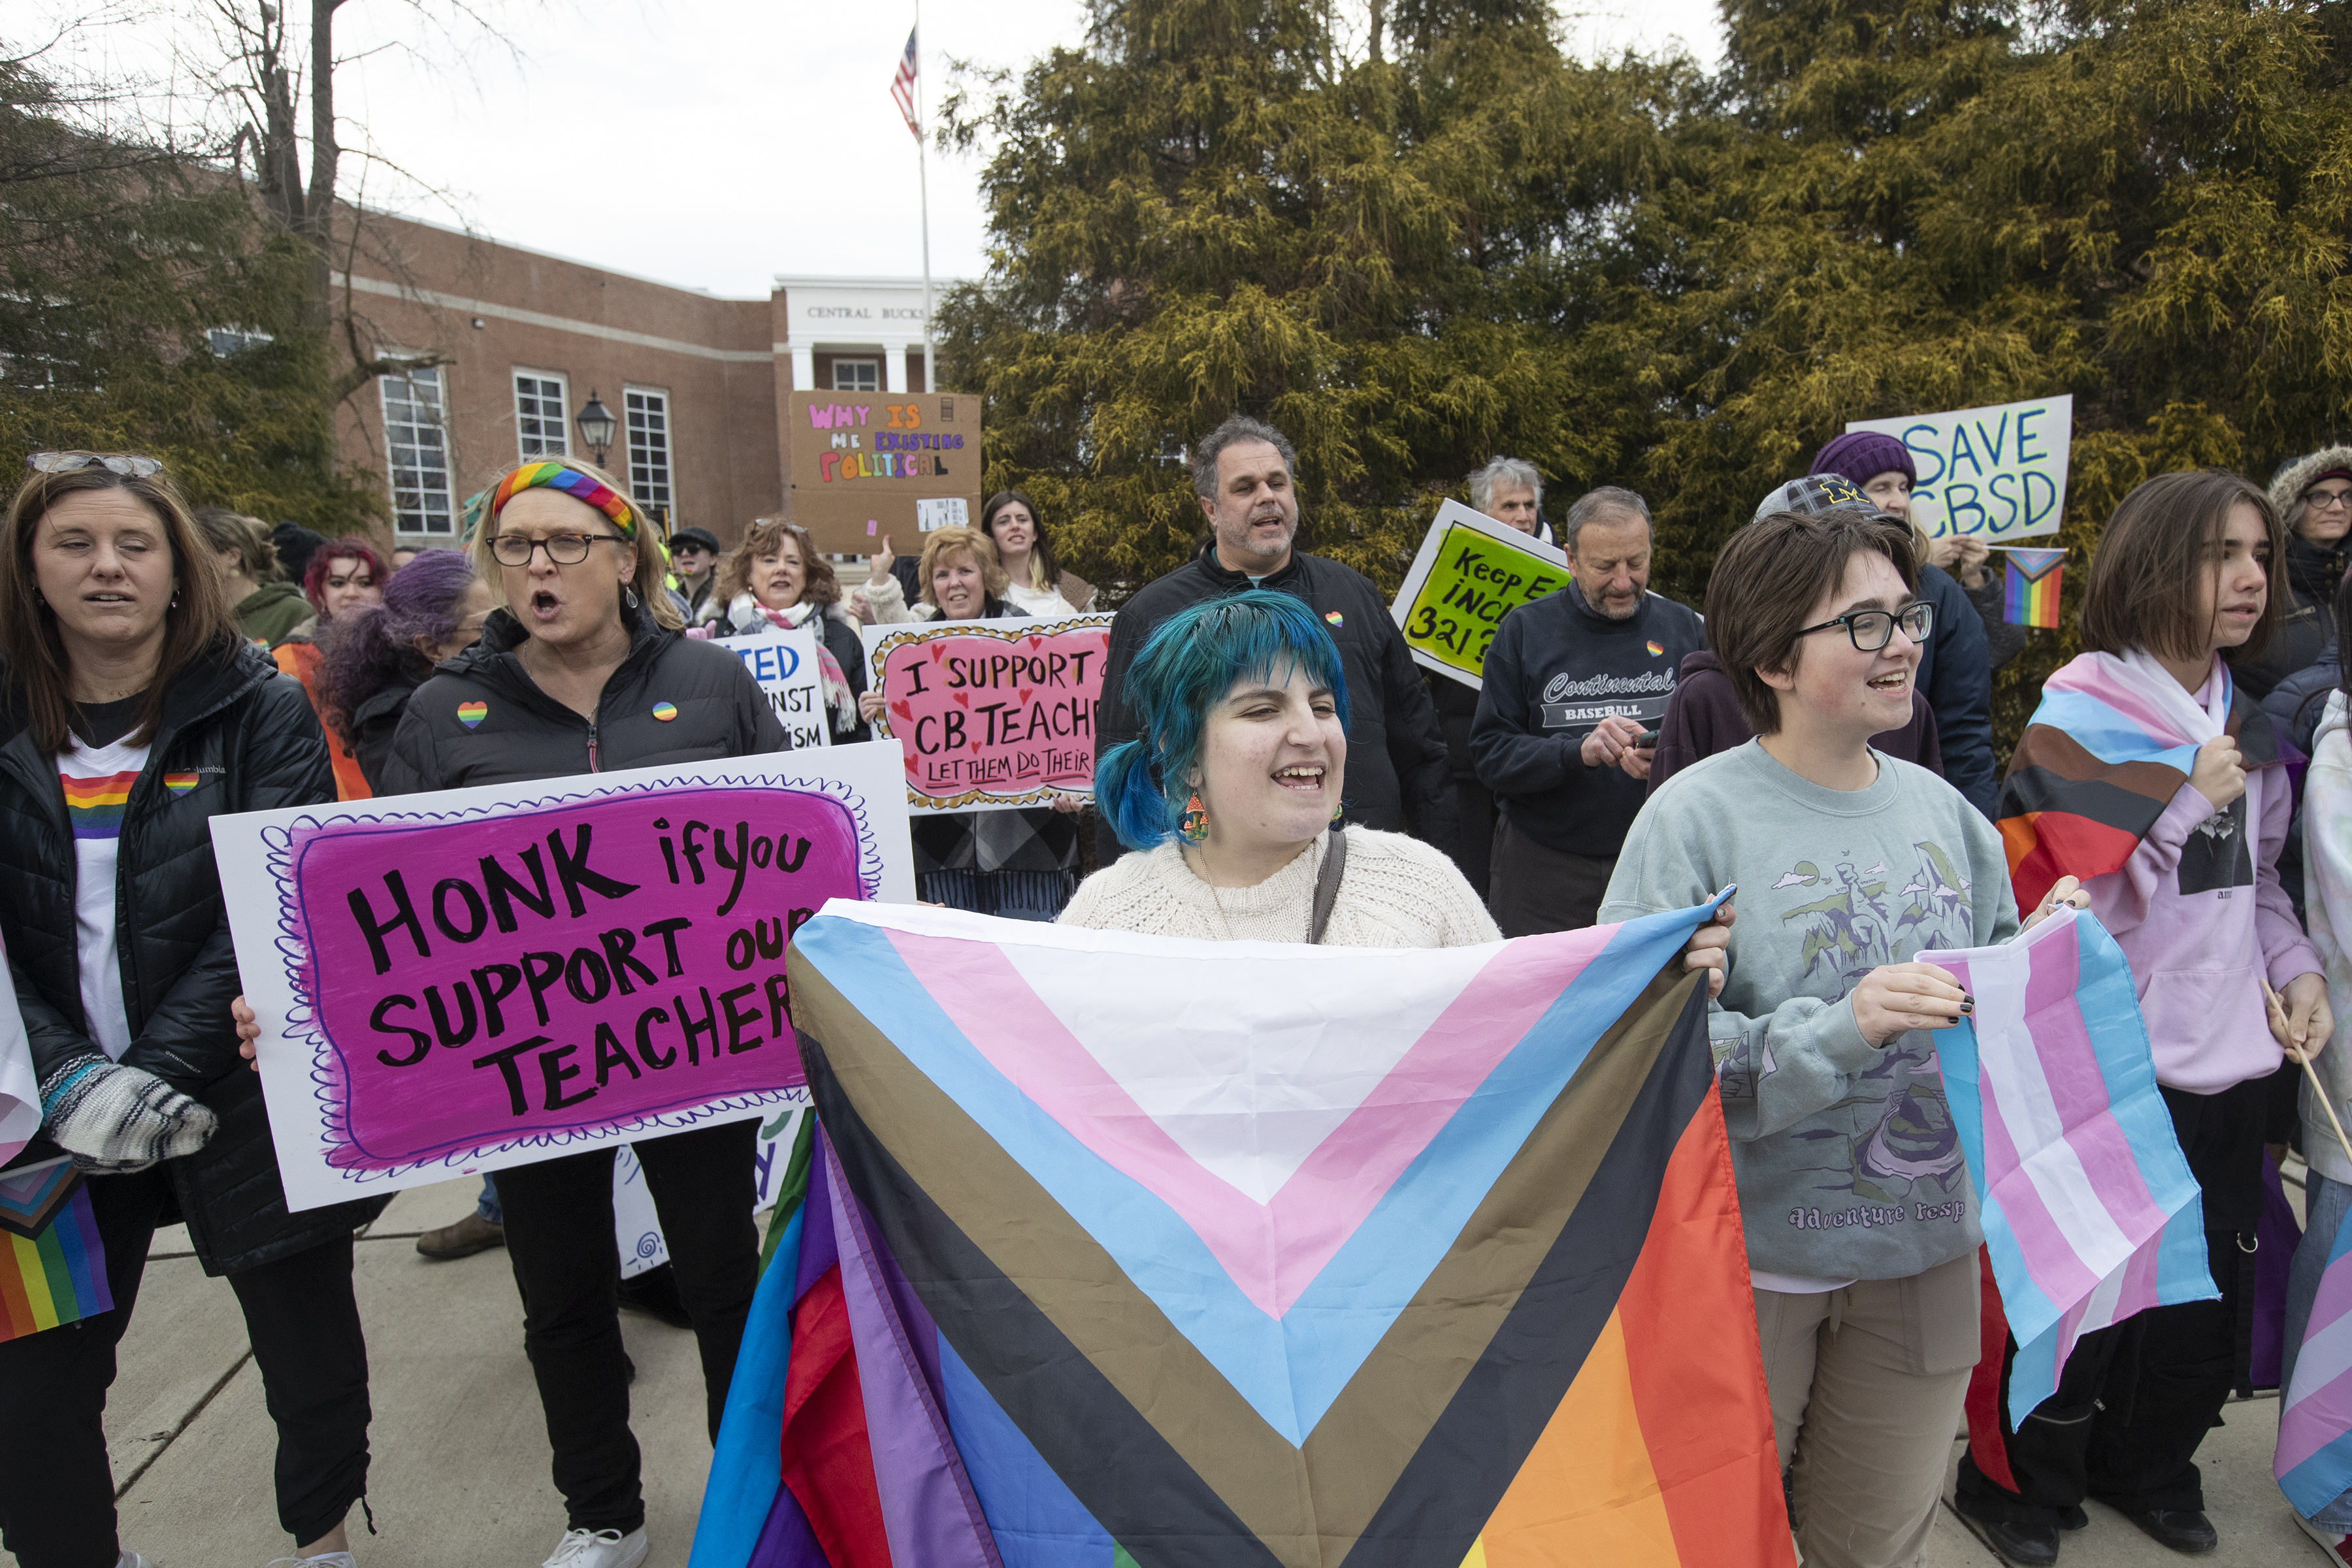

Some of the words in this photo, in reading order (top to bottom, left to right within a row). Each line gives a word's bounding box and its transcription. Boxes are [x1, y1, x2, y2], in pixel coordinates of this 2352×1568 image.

[808, 306, 872, 319] CENTRAL
[882, 307, 925, 319] BUCKS
[808, 403, 870, 429] WHY
[886, 404, 921, 429] IS
[830, 432, 860, 449] ME
[875, 431, 964, 451] EXISTING
[1902, 408, 2048, 487] SAVE
[819, 451, 948, 482] POLITICAL
[1820, 478, 1870, 504] M
[1453, 546, 1522, 597] Keep
[901, 660, 930, 697] I
[948, 650, 1095, 689] SUPPORT
[1543, 667, 1678, 703] Continental
[1565, 704, 1642, 721] BASEBALL
[915, 709, 967, 755] CB
[183, 764, 225, 774] lumbia
[928, 759, 964, 781] LET
[966, 756, 1012, 780] THEM
[1017, 751, 1039, 774] DO
[1041, 748, 1090, 776] THEIR
[346, 823, 640, 975] HONK
[368, 917, 692, 1068] SUPPORT
[472, 973, 795, 1117] TEACHER
[1788, 1204, 1904, 1230] adventure
[1915, 1201, 1966, 1224] resp
